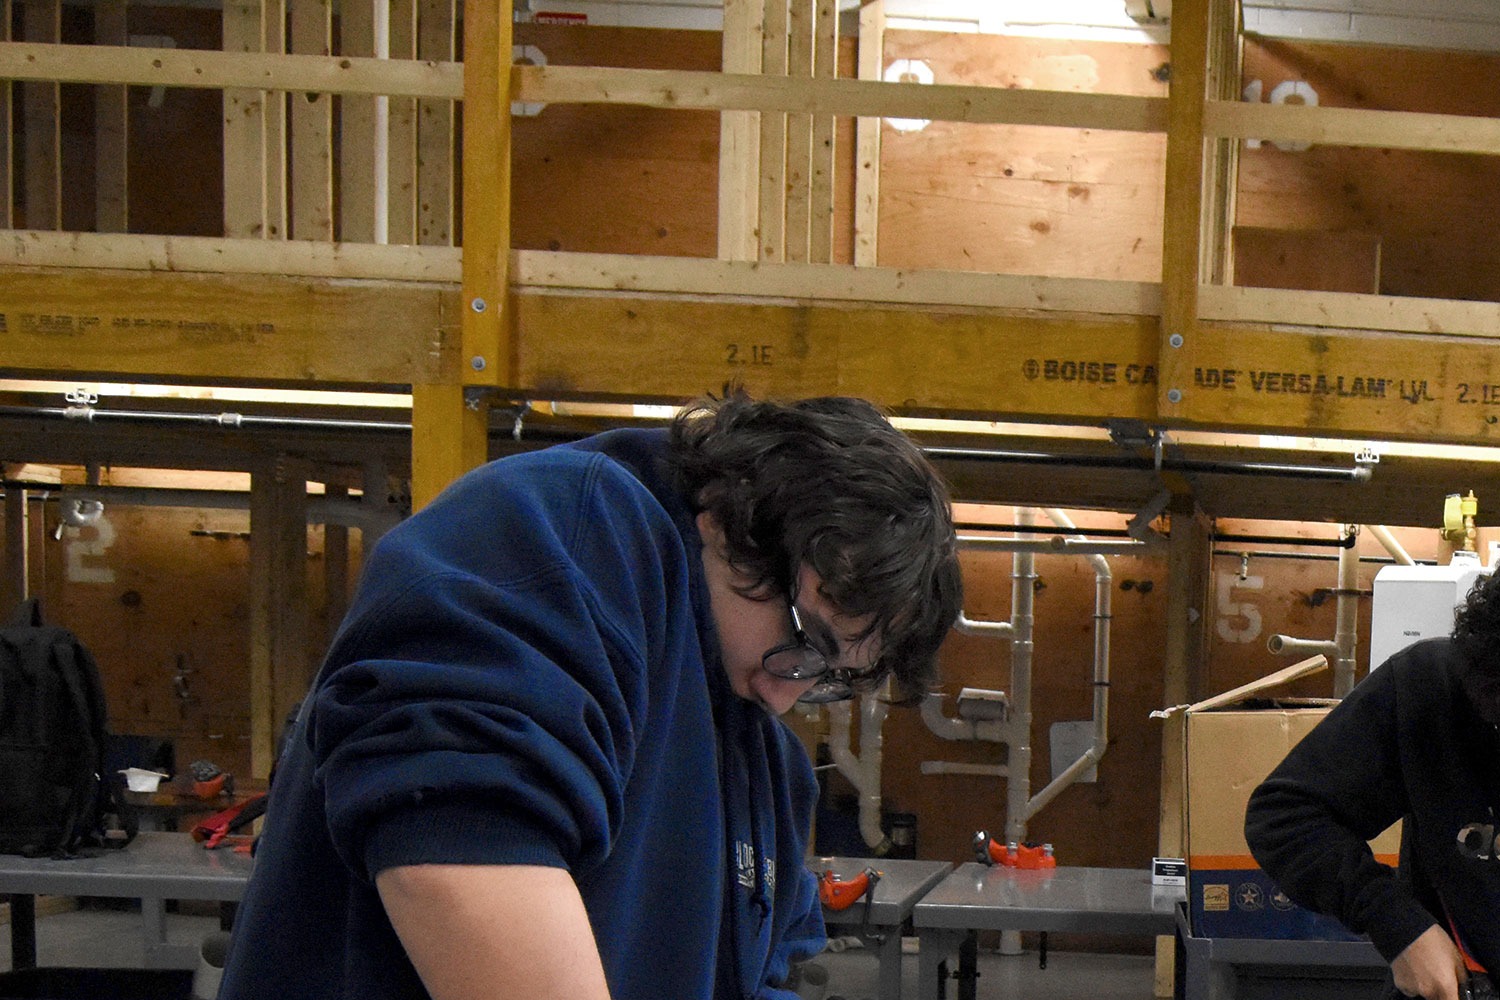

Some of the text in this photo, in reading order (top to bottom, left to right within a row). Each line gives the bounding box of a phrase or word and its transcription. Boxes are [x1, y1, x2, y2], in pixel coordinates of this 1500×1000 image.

[726, 343, 773, 366] 2.1E
[1044, 360, 1117, 384] BOISE
[1217, 572, 1264, 643] 5
